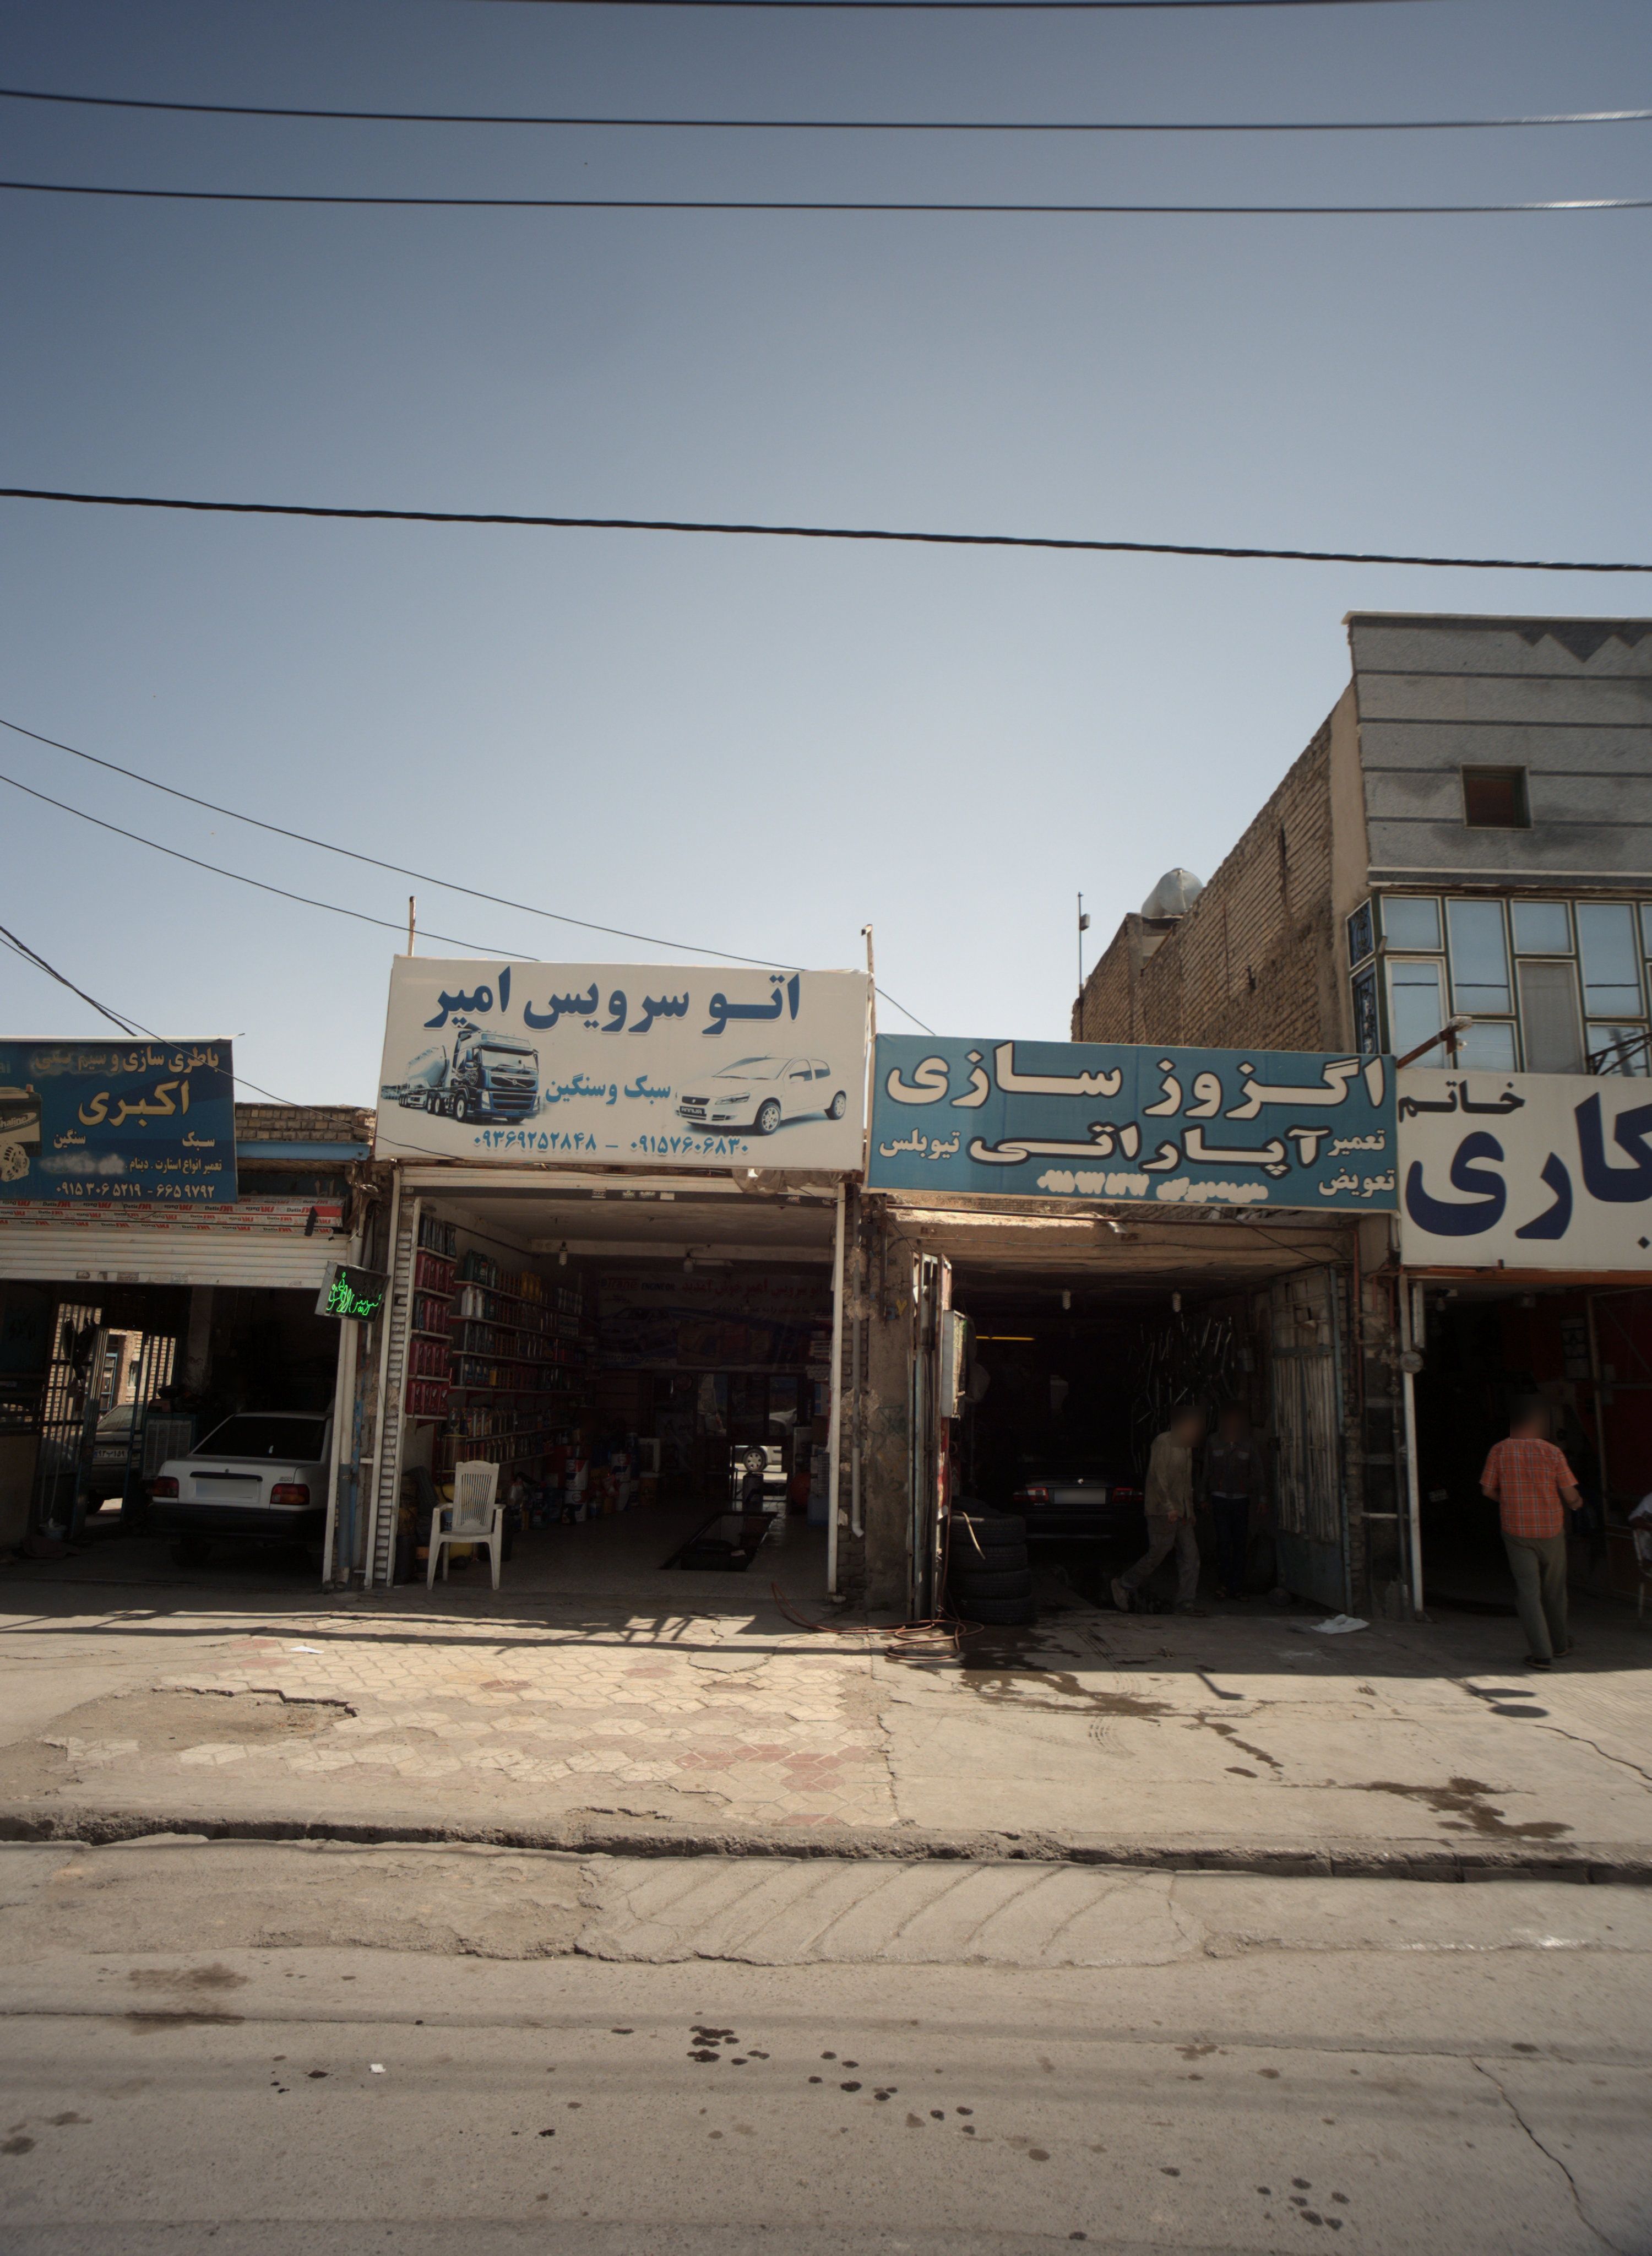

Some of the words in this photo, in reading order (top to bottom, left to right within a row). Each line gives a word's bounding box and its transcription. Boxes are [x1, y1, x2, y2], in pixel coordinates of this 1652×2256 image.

[423, 965, 511, 1028] امیر
[524, 982, 689, 1033] سرویس
[702, 973, 800, 1035] اتو
[110, 1053, 119, 1072] و
[122, 1045, 165, 1073] سازی
[168, 1046, 219, 1073] باطری
[887, 1041, 1122, 1108] سازی
[1143, 1056, 1385, 1120] اگزوز
[78, 1080, 189, 1127] اکبری
[624, 1075, 671, 1105] سبک
[1398, 1080, 1526, 1124] خاتم
[0, 1116, 28, 1129] haline
[53, 1129, 86, 1149] سنگین
[182, 1131, 215, 1151] سبک
[474, 1130, 597, 1151] ۰۹۳۶۹۲۵۲۸۴۸
[631, 1135, 748, 1156] ۰۹۱۵۷۶۰۶۸۳۰
[878, 1127, 961, 1160] تیوبلس
[969, 1122, 1330, 1176] آپاراتی
[1328, 1128, 1385, 1156] تعمیر
[129, 1157, 149, 1173] دینام
[155, 1157, 181, 1174] استارت
[182, 1158, 202, 1174] انواع
[202, 1159, 222, 1175] تعمیر
[56, 1181, 83, 1196] ۰۹۱۵
[86, 1183, 110, 1196] ۳۰۶
[112, 1183, 142, 1197] ۵۲۱۹
[156, 1184, 182, 1198] ۶۶۵
[184, 1184, 215, 1198] ۹۷۹۲
[1319, 1168, 1396, 1198] تعویض
